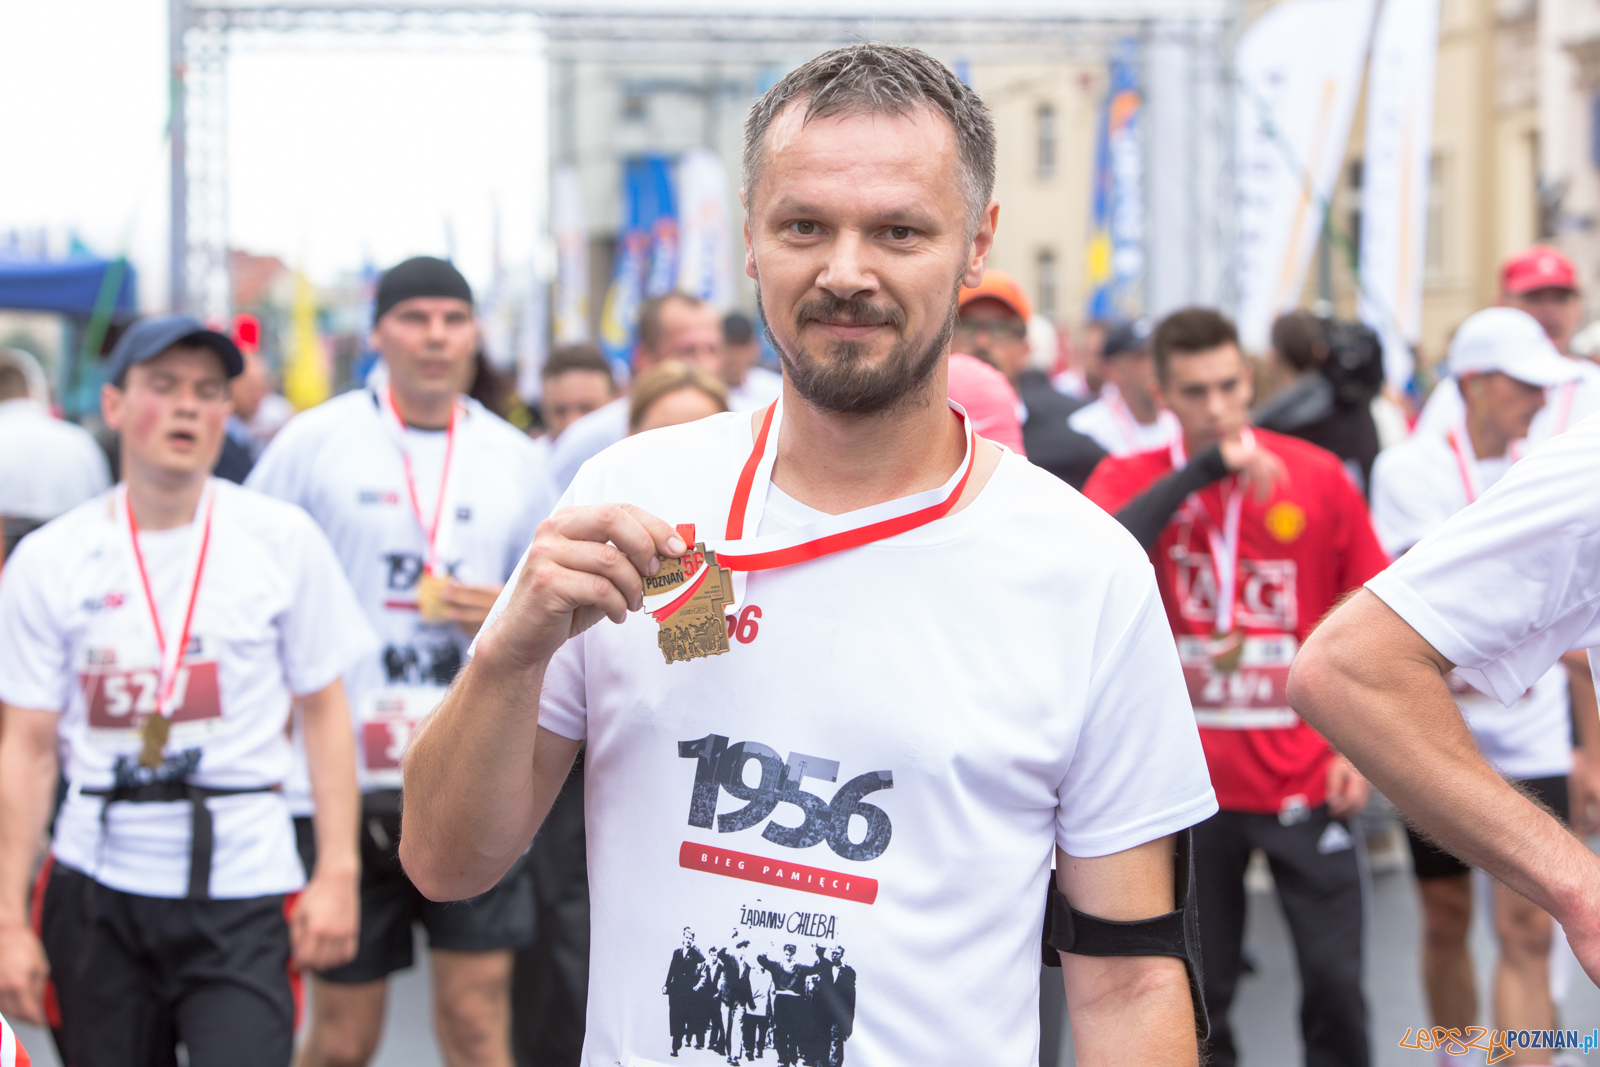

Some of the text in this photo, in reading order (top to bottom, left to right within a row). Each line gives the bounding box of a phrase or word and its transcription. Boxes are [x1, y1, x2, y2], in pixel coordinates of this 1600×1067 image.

[645, 569, 685, 590] POZNAŃ
[677, 732, 894, 862] 1956
[701, 853, 851, 892] BIEG PAMIĘCI
[739, 904, 836, 940] ŻĄDAMY CHLEBA
